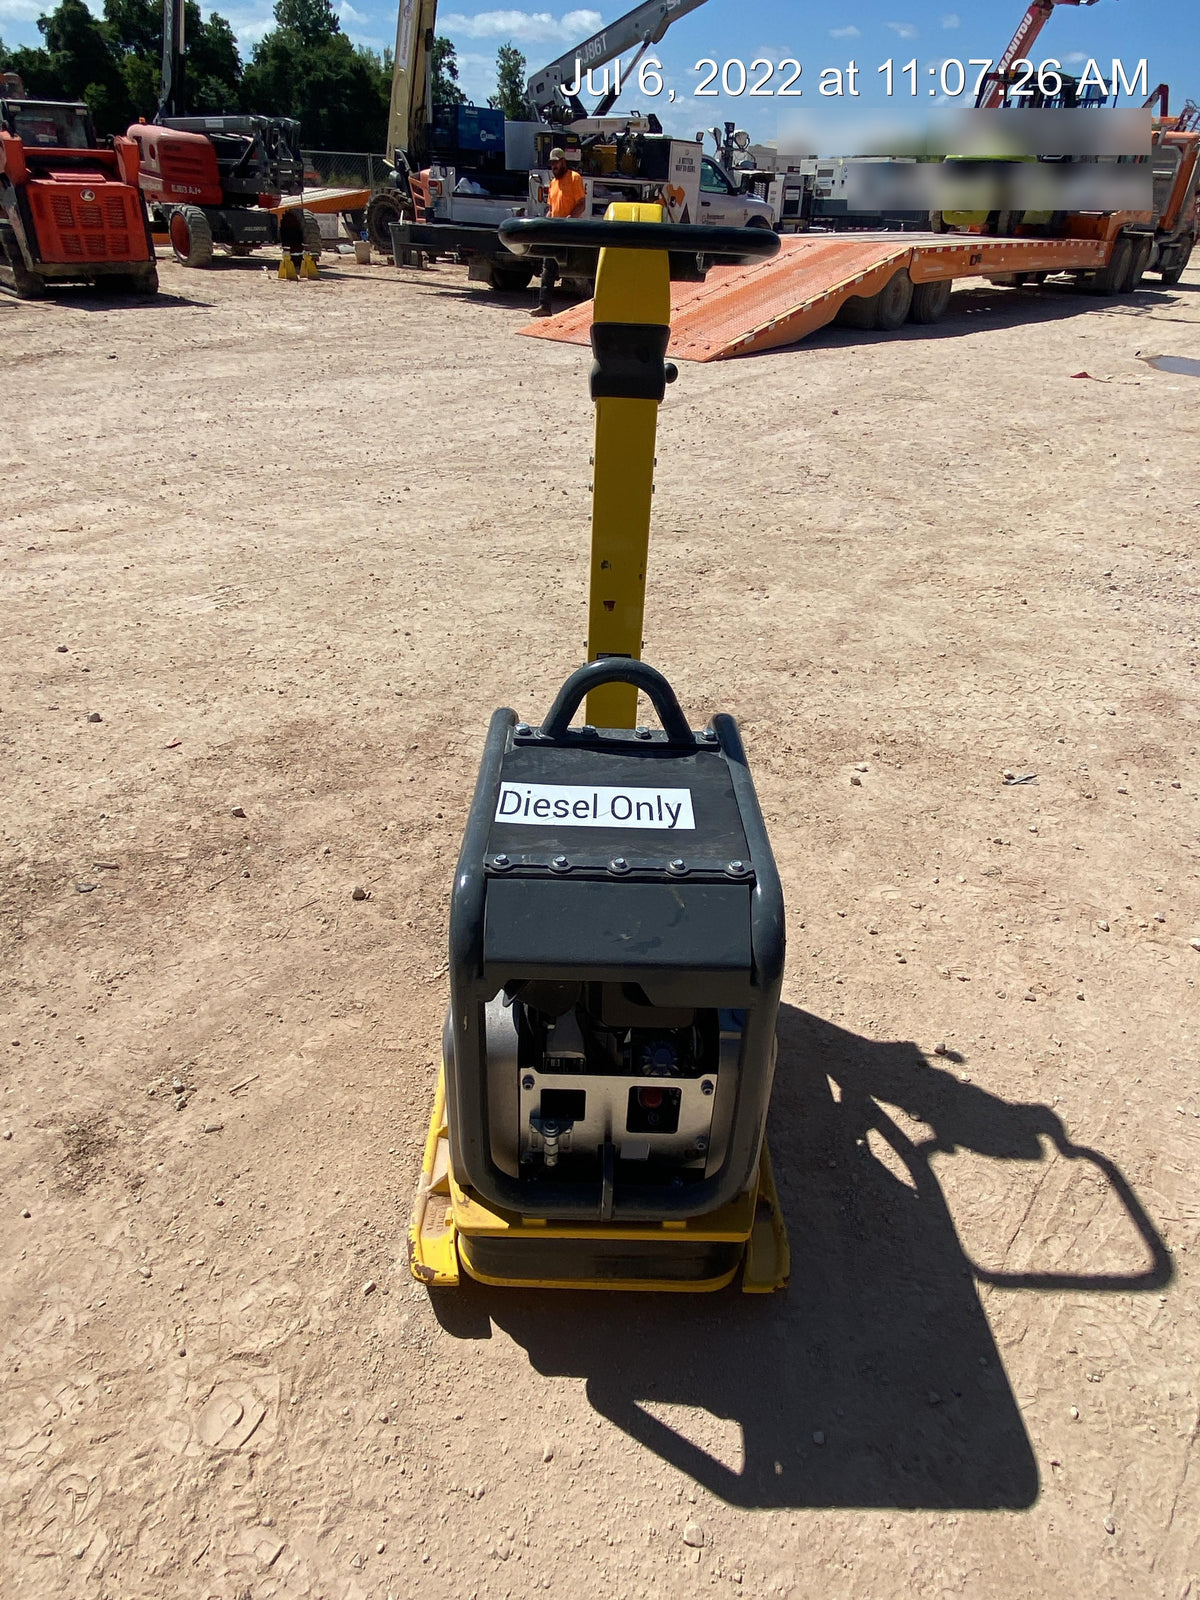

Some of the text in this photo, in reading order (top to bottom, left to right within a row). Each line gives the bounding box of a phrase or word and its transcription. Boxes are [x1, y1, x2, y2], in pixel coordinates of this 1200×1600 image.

[575, 32, 607, 66] SJ86T
[997, 13, 1033, 71] MANITOU
[498, 790, 683, 829] Diesel Only
